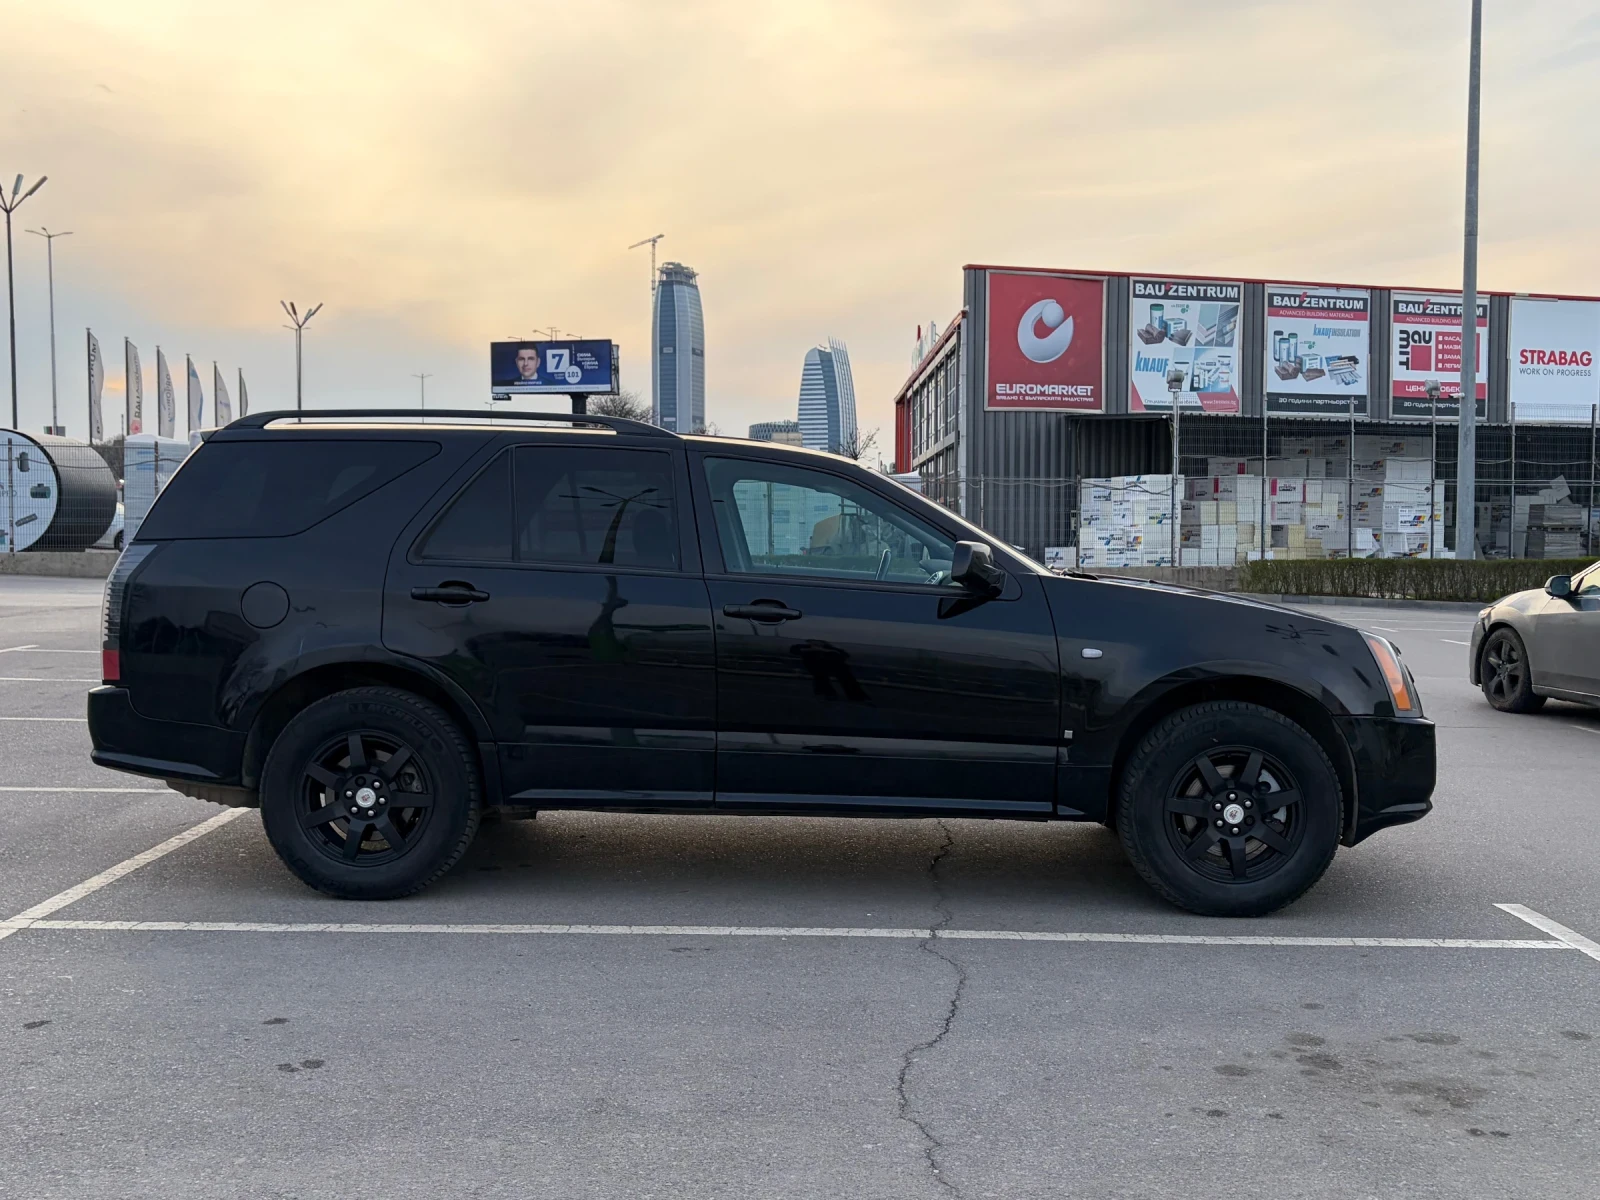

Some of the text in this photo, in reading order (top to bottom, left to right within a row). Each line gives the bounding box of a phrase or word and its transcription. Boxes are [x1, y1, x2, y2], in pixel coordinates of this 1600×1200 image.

[1425, 305, 1483, 317] ZENTRM
[552, 353, 564, 370] 7
[1134, 350, 1170, 378] KNAUF
[1519, 349, 1593, 367] STRABAG
[567, 371, 580, 379] 101
[1519, 367, 1592, 377] WORK ON PROGRESS
[996, 383, 1094, 396] EUROMARKET
